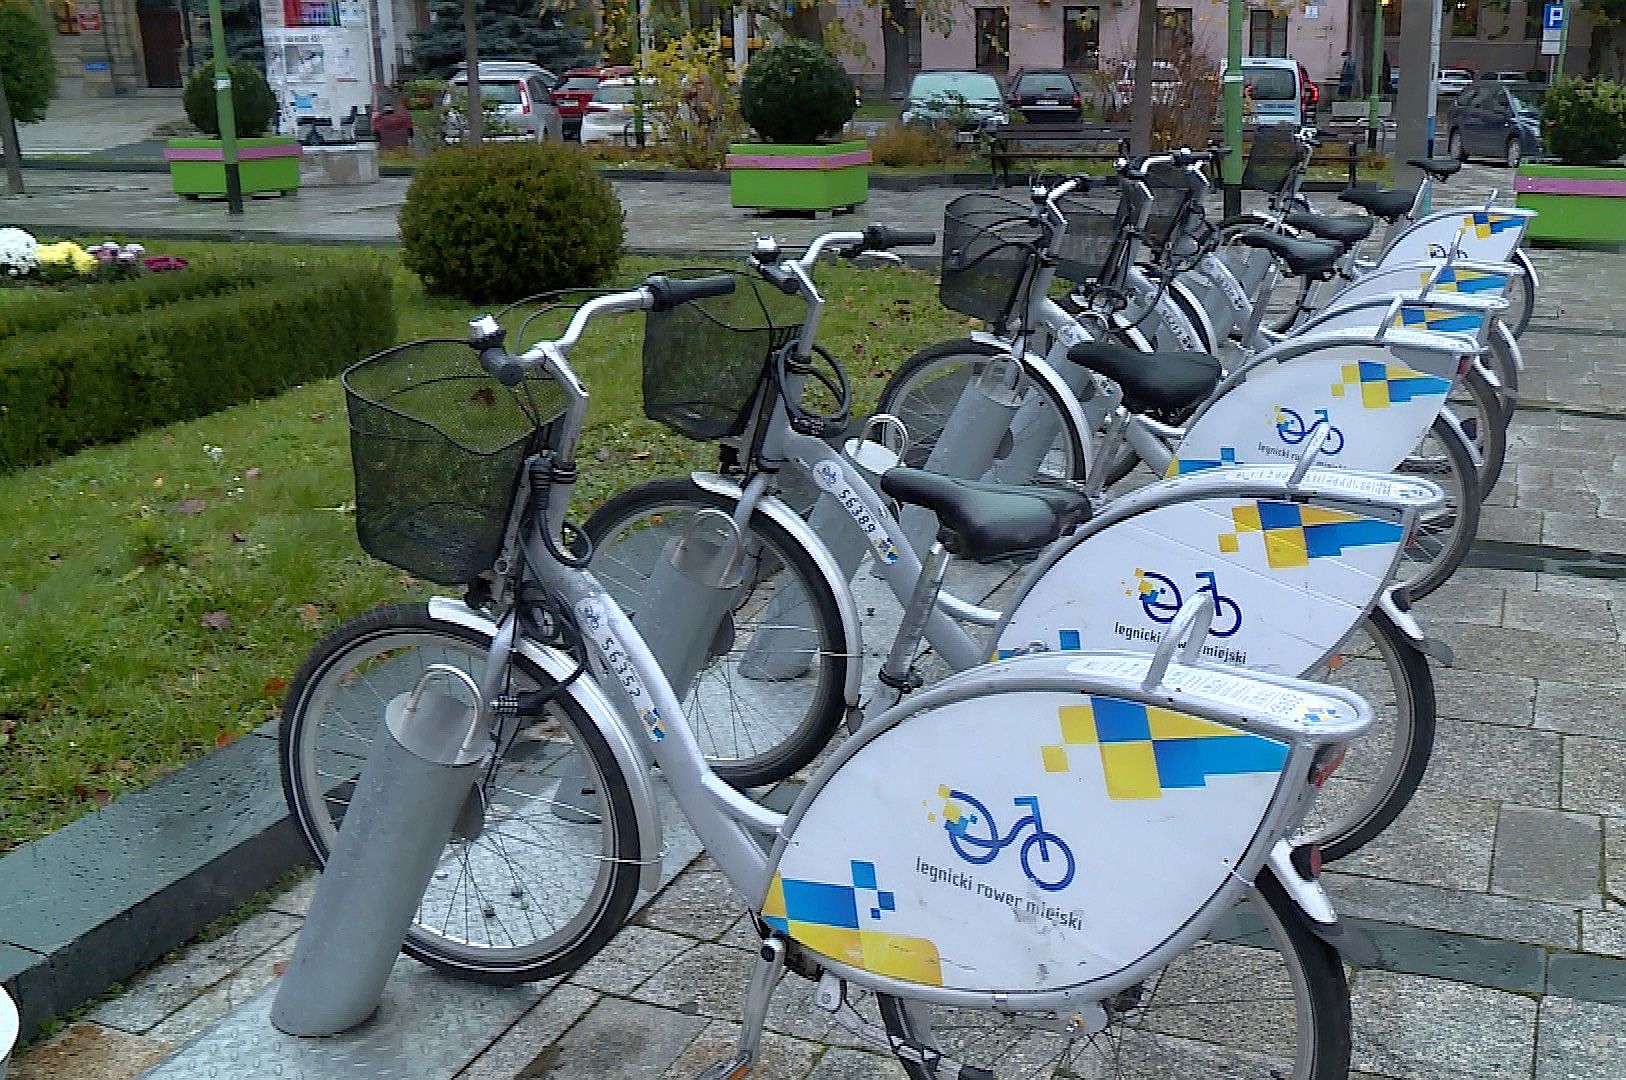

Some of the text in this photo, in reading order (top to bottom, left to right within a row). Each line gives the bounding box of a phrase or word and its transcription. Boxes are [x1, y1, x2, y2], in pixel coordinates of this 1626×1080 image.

[1549, 7, 1564, 27] P
[839, 489, 876, 533] 56389
[1114, 621, 1162, 643] legnicki
[1202, 645, 1247, 664] miejski
[915, 855, 1083, 931] legnicki rower miejski
